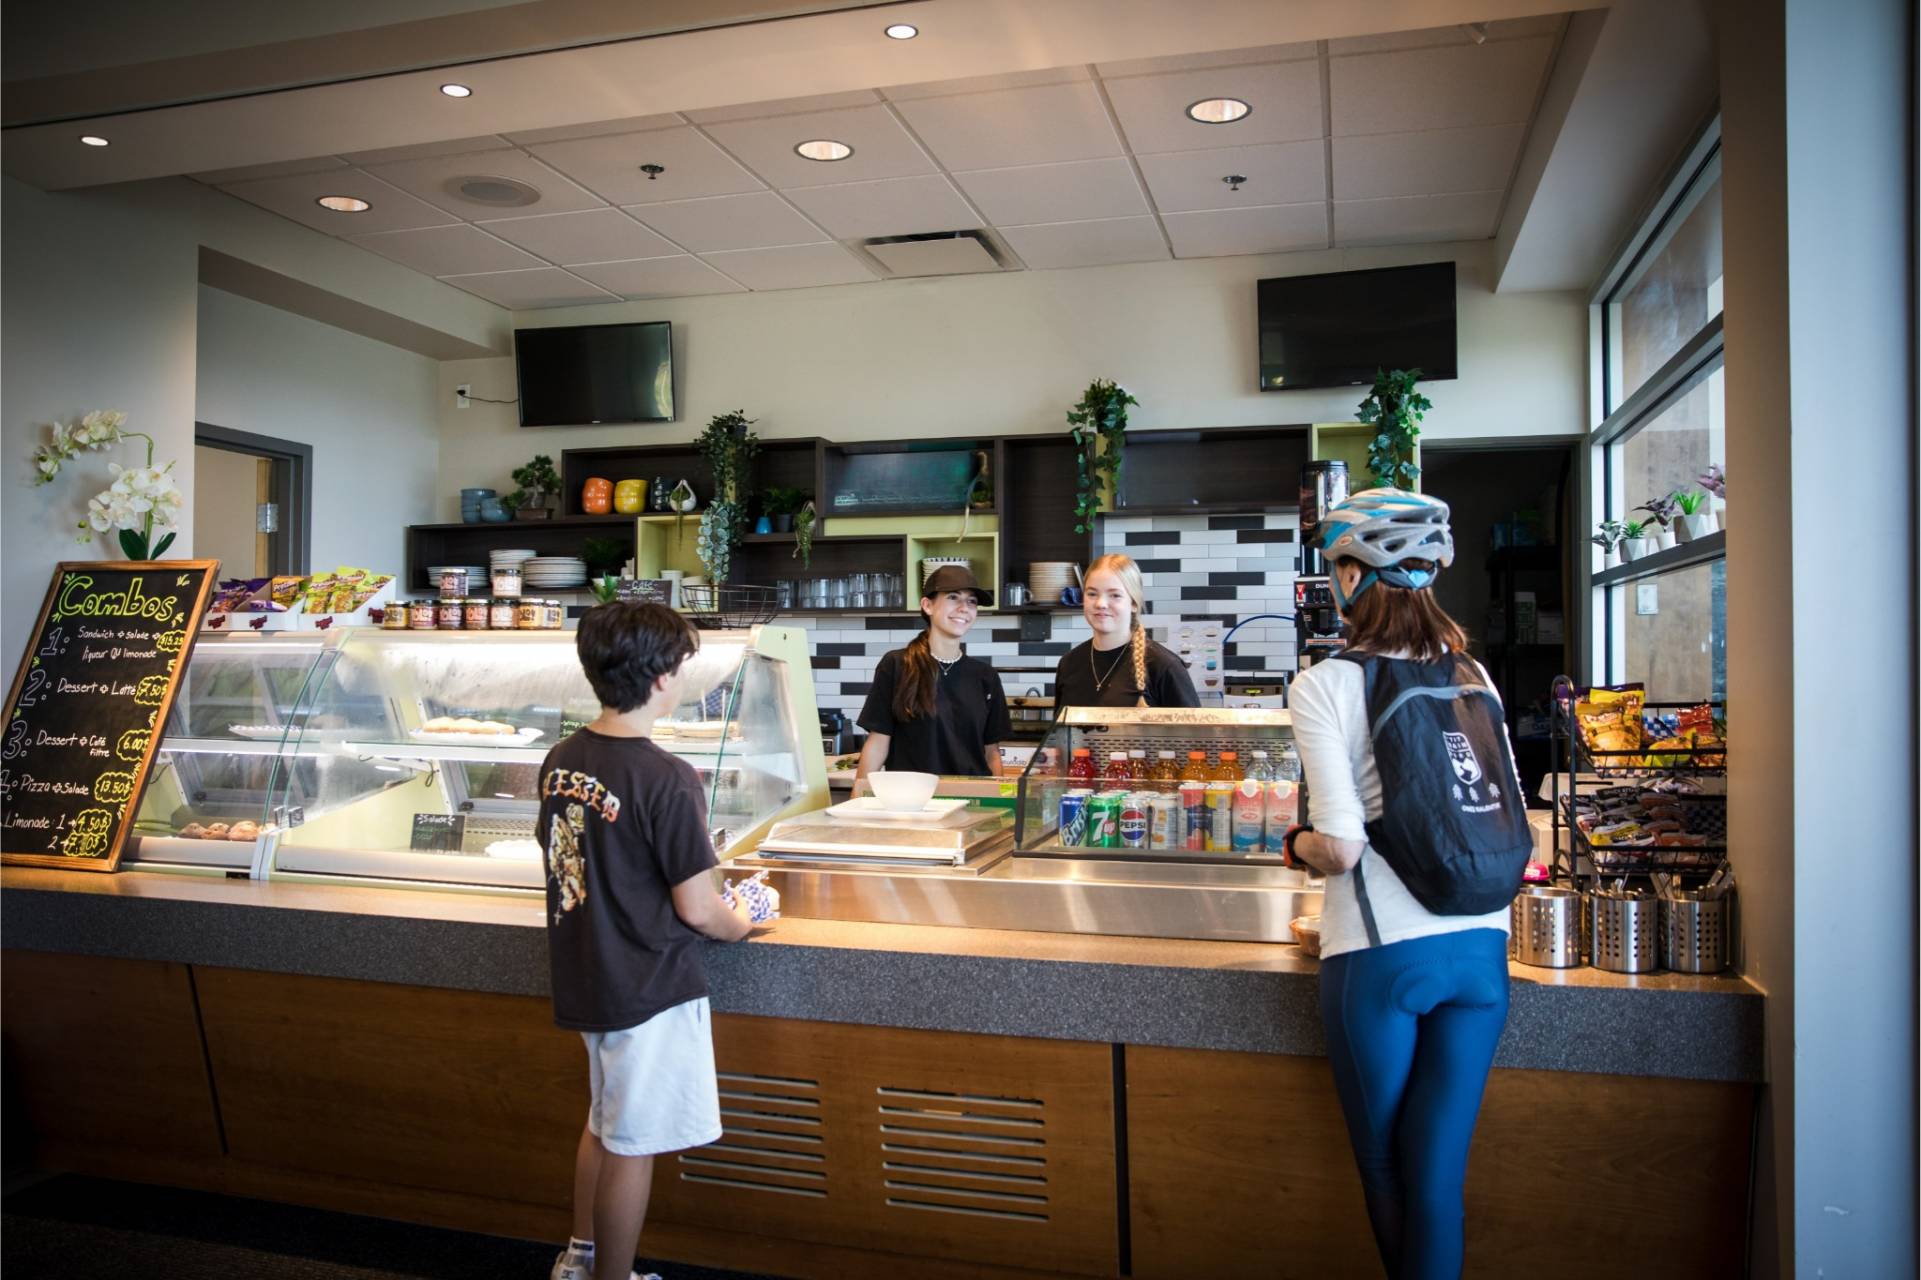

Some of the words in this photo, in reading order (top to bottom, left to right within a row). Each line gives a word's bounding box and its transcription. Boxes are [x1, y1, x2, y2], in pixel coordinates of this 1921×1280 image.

[59, 575, 178, 621] Combos
[77, 626, 115, 639] Sandwich
[57, 677, 99, 694] Dessert
[36, 729, 78, 747] Dessert
[19, 773, 51, 793] Pizza
[2, 810, 50, 829] Limonade
[1120, 820, 1146, 829] PEPSI
